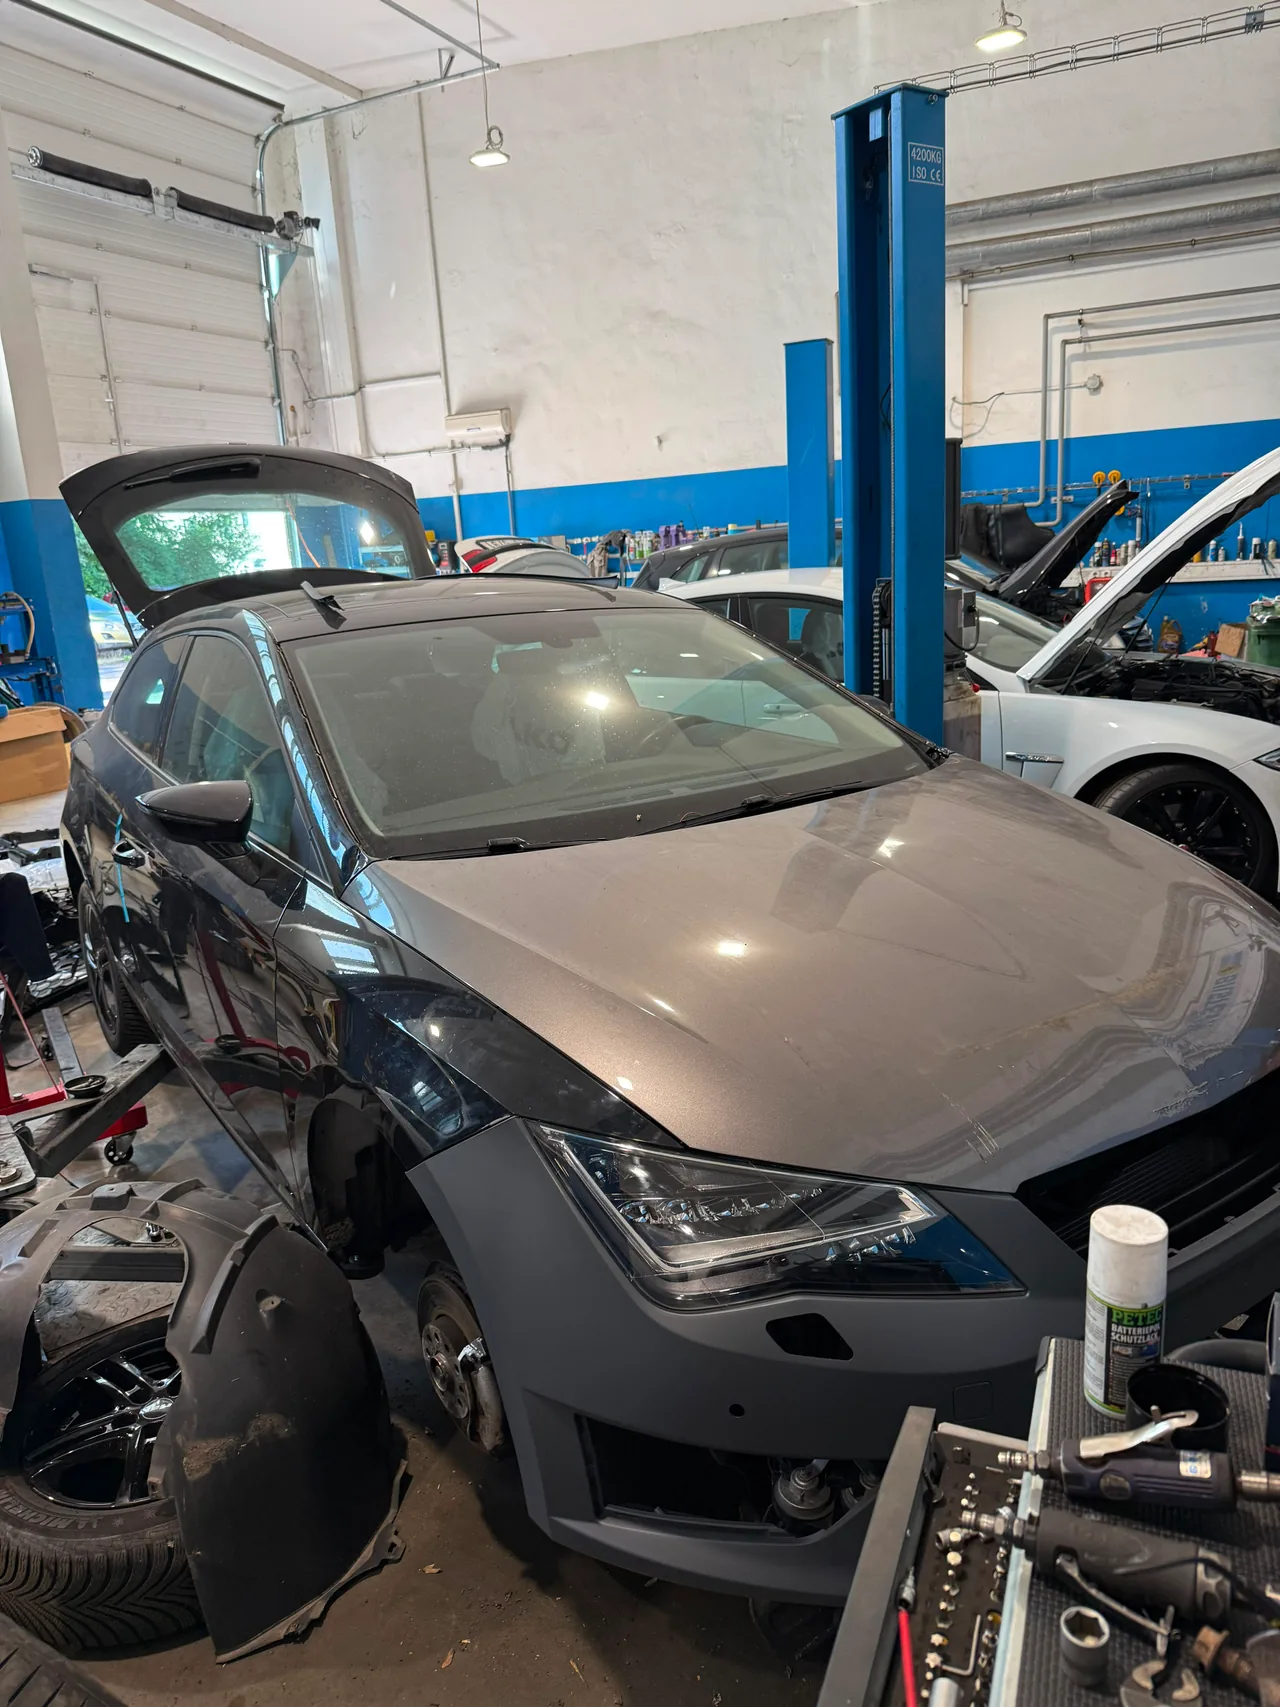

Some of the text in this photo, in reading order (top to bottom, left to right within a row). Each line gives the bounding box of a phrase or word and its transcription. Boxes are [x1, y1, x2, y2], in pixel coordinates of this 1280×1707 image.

[911, 147, 942, 164] 4200KG
[912, 165, 927, 180] ISO
[1111, 1308, 1162, 1326] PETEC
[1110, 1332, 1160, 1344] SCHUTZLACK
